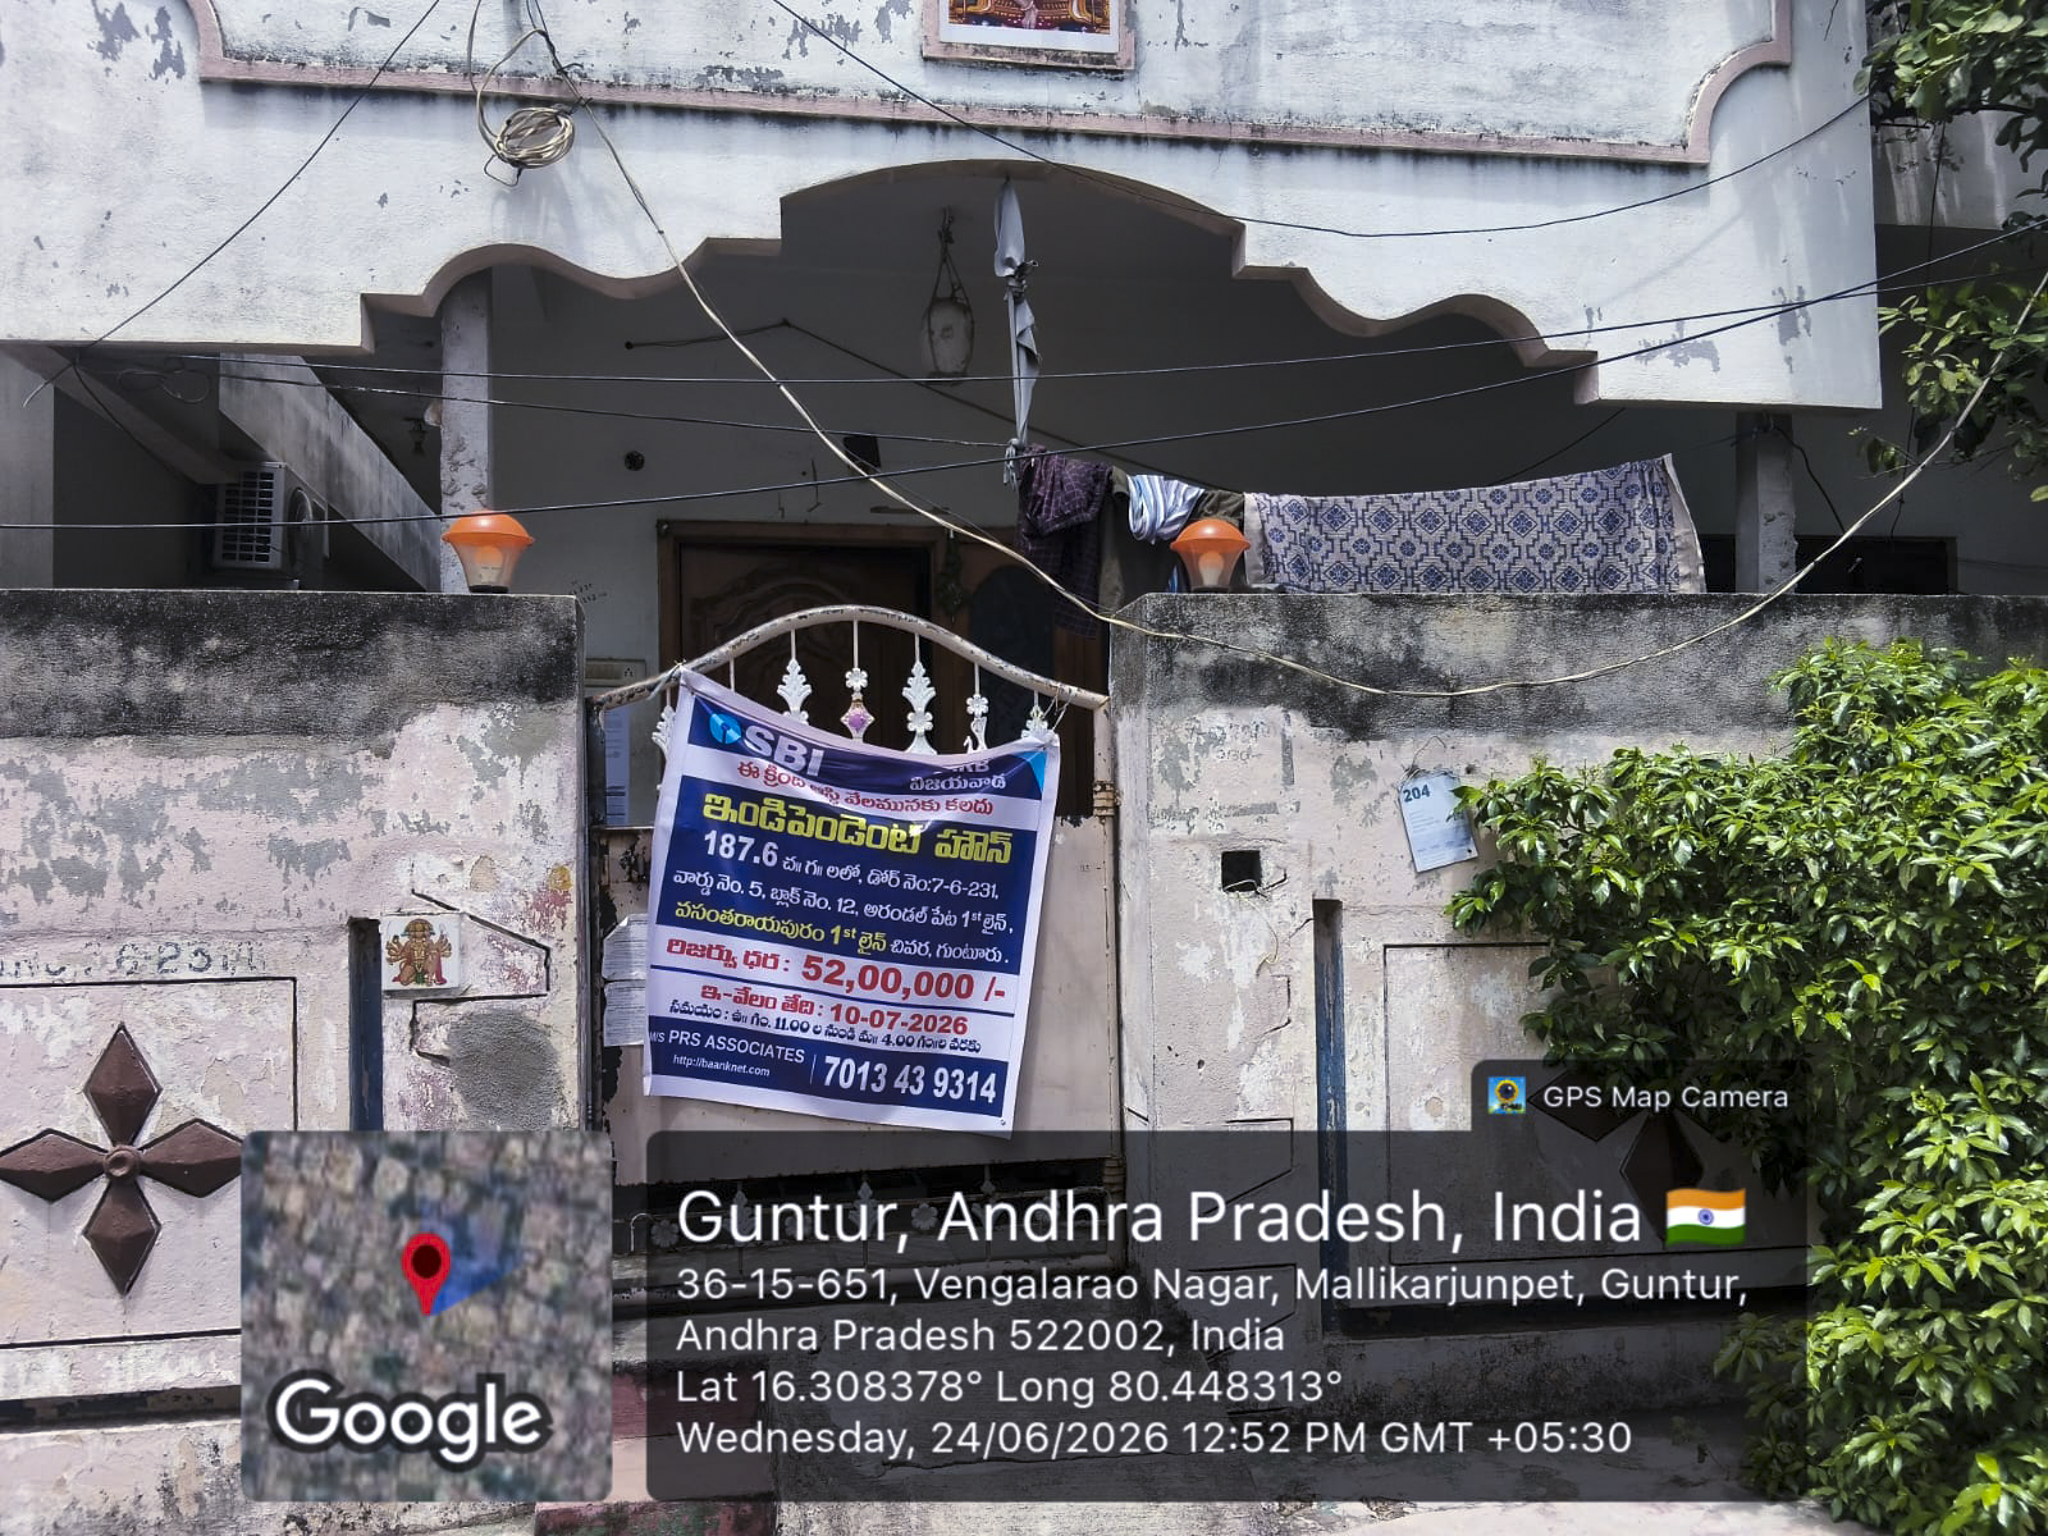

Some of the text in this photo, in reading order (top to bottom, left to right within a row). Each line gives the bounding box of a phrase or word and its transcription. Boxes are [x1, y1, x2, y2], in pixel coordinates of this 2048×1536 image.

[744, 725, 825, 776] SBI
[737, 761, 760, 779] ఈ
[845, 789, 940, 813] వేలమునకు
[945, 798, 993, 815] కలదు
[909, 772, 1006, 790] విజయవాడ
[1403, 784, 1430, 803] 204
[704, 829, 778, 867] 187.6
[866, 869, 900, 886] డోర్
[673, 870, 714, 896] వార్డు
[716, 873, 744, 894] నెం.
[770, 886, 801, 908] బ్లాక్
[803, 890, 832, 911] నెం.
[863, 903, 928, 924] అరండల్
[931, 905, 957, 927] పేట
[961, 911, 982, 928] 1st
[675, 901, 825, 942] వసంతరాయపురం
[830, 925, 857, 945] 1st
[858, 932, 887, 955] లైన్
[666, 938, 737, 969] రిజర్వు
[801, 953, 975, 1000] 52,00,000
[669, 999, 722, 1018] సమయం
[775, 1016, 810, 1033] 11.00
[881, 1033, 915, 1048] 4.00
[949, 1036, 981, 1054] వరకు
[781, 993, 815, 1016] తేది
[830, 1003, 969, 1035] 10-07-2026
[668, 1030, 701, 1047] PRS
[704, 1035, 805, 1063] ASSOCIATES
[673, 1054, 770, 1076] http://baanknet.com
[824, 1055, 997, 1104] 7013 43 9314
